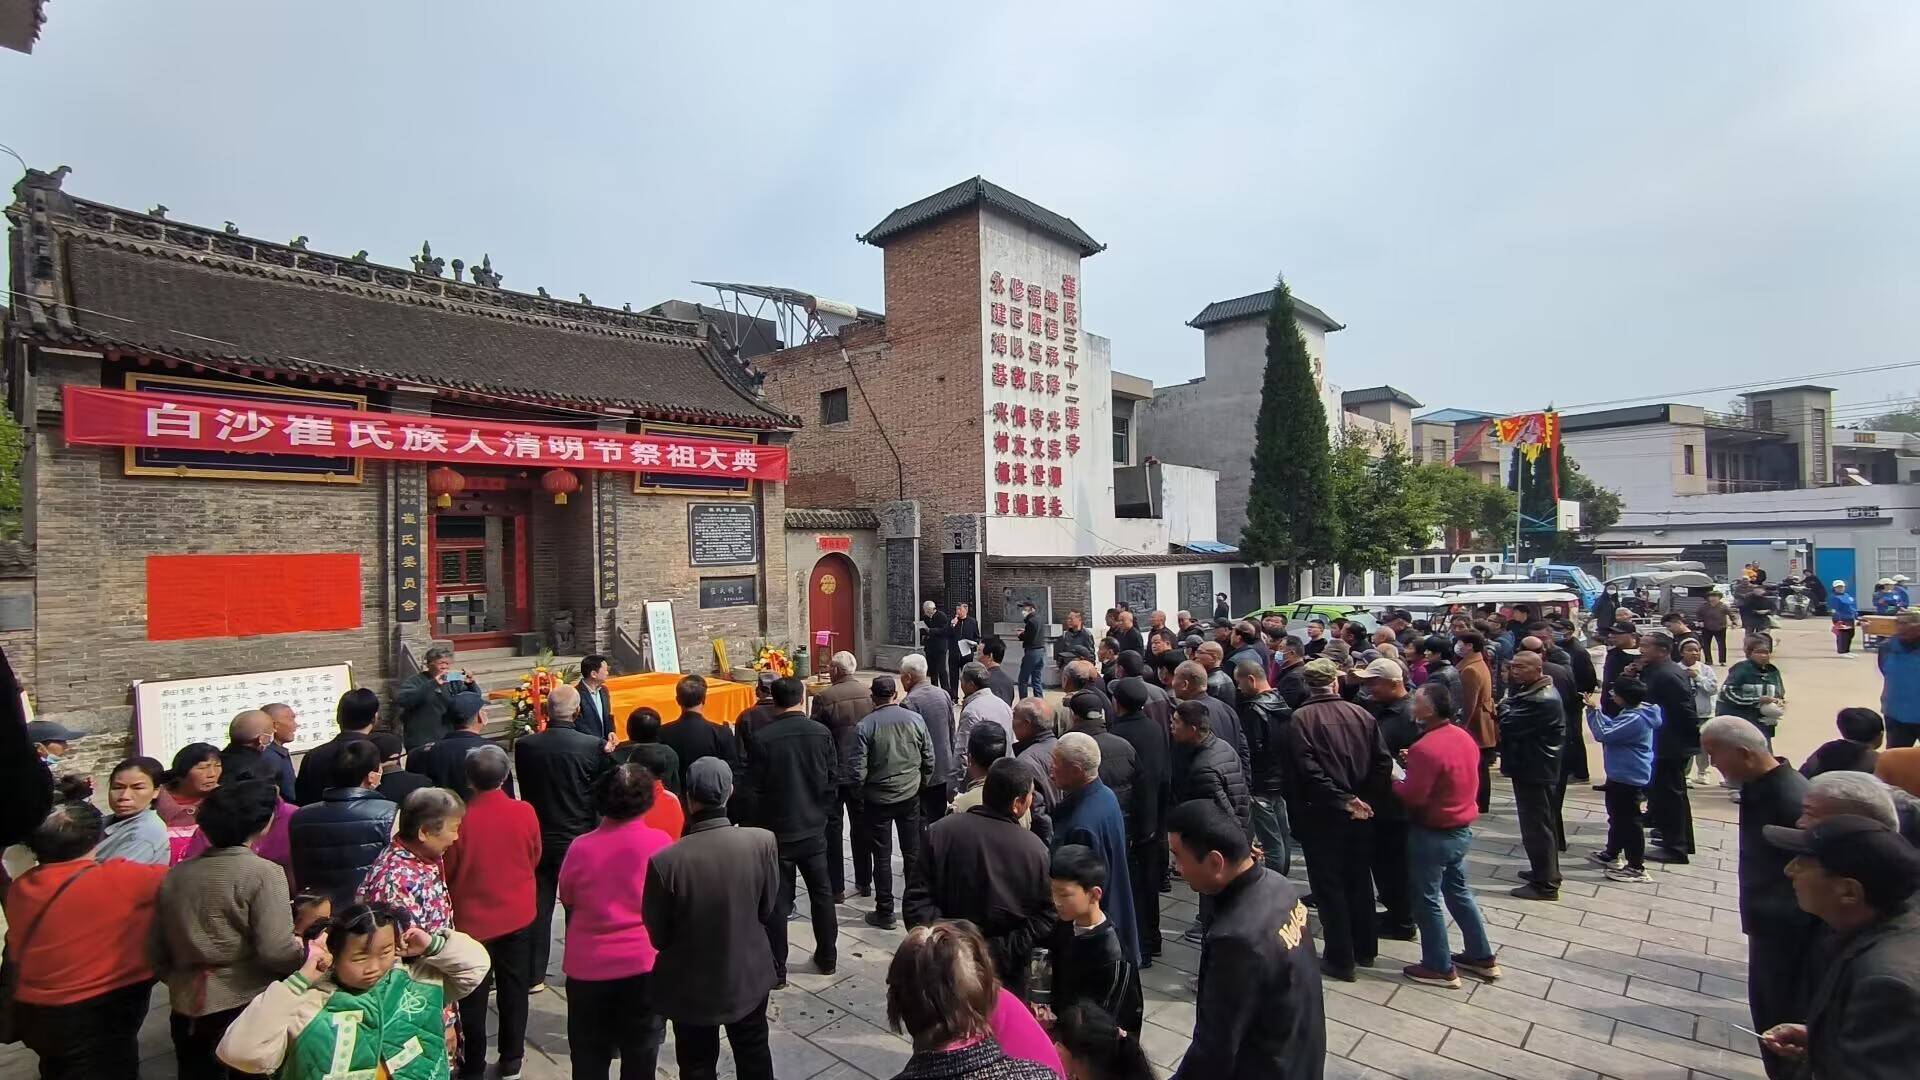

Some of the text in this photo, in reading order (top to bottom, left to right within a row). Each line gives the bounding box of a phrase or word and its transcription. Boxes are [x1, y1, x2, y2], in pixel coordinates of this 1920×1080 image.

[1062, 274, 1081, 457] 崔氏三十二辈字
[146, 402, 758, 473] 白沙崔氏族人清明节祭祖大典
[401, 512, 417, 612] 崔氏委员会
